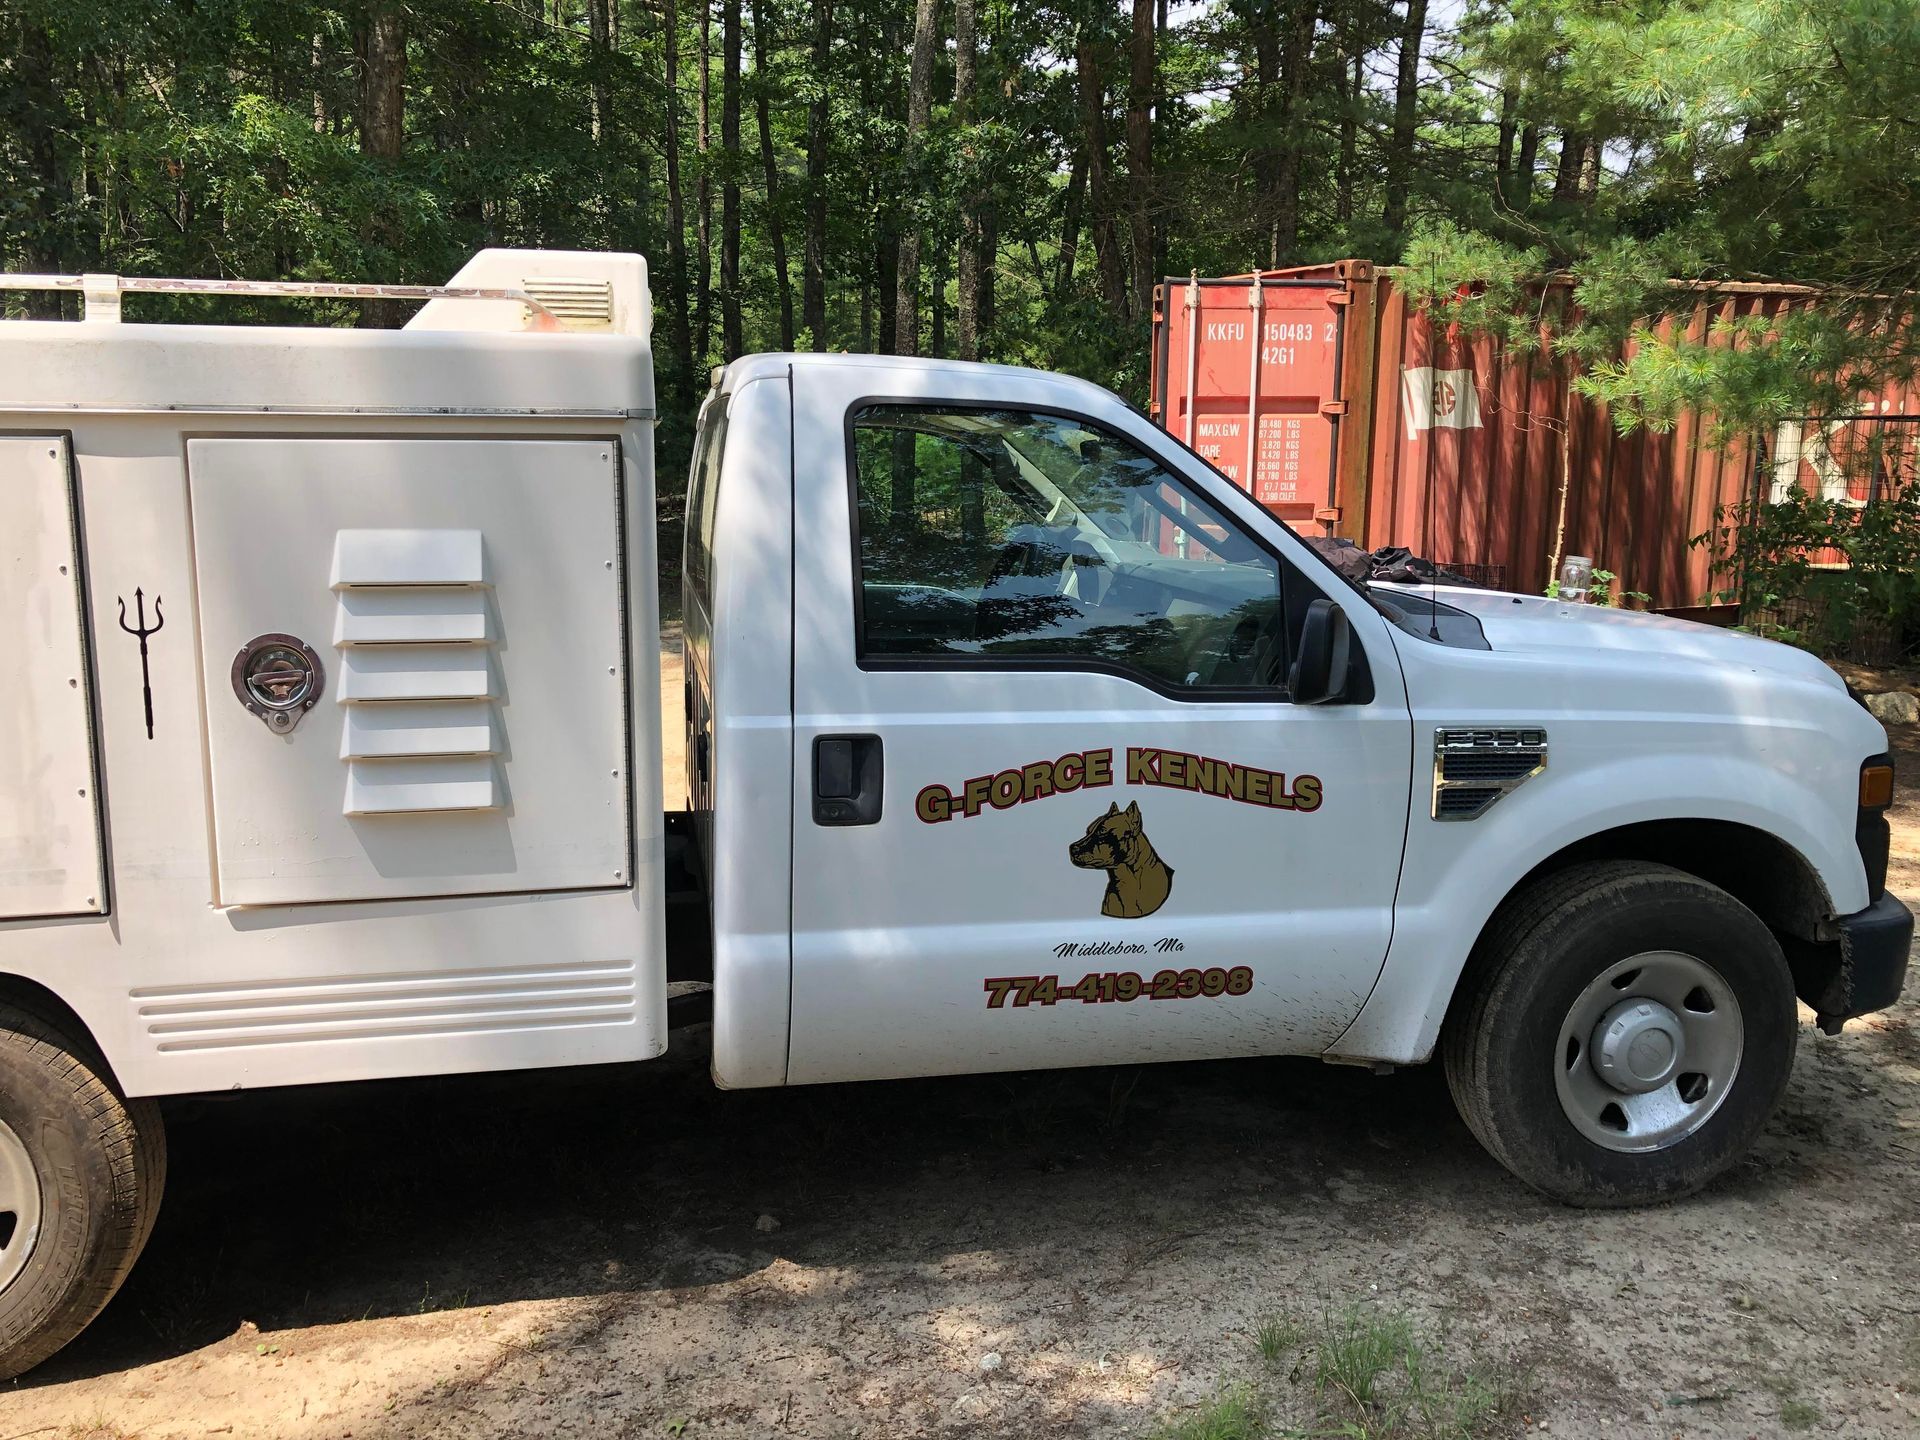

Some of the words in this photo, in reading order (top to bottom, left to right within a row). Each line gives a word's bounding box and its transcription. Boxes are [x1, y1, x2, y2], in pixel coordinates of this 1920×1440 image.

[1208, 323, 1244, 341] KKFU
[1264, 323, 1313, 341] 150483
[1325, 323, 1335, 342] 2
[1262, 347, 1295, 365] 42G1
[1259, 419, 1282, 429] 30.480
[1287, 419, 1301, 429] KGS
[1258, 430, 1281, 439] 67.200
[1286, 430, 1300, 439] LBS
[1262, 440, 1281, 449] 3.820
[1286, 440, 1299, 449] KGS
[1199, 444, 1221, 458] TARE
[1285, 451, 1299, 459] LBS
[1285, 461, 1298, 471] KGS
[1284, 472, 1298, 480] LBS
[1264, 482, 1279, 491] 67.7
[916, 748, 1113, 824] G-FORCE
[1126, 747, 1323, 812] KENNELS
[1053, 941, 1148, 958] Middleboro,
[1153, 937, 1185, 953] Ma
[984, 965, 1254, 1009] 774-419-2398
